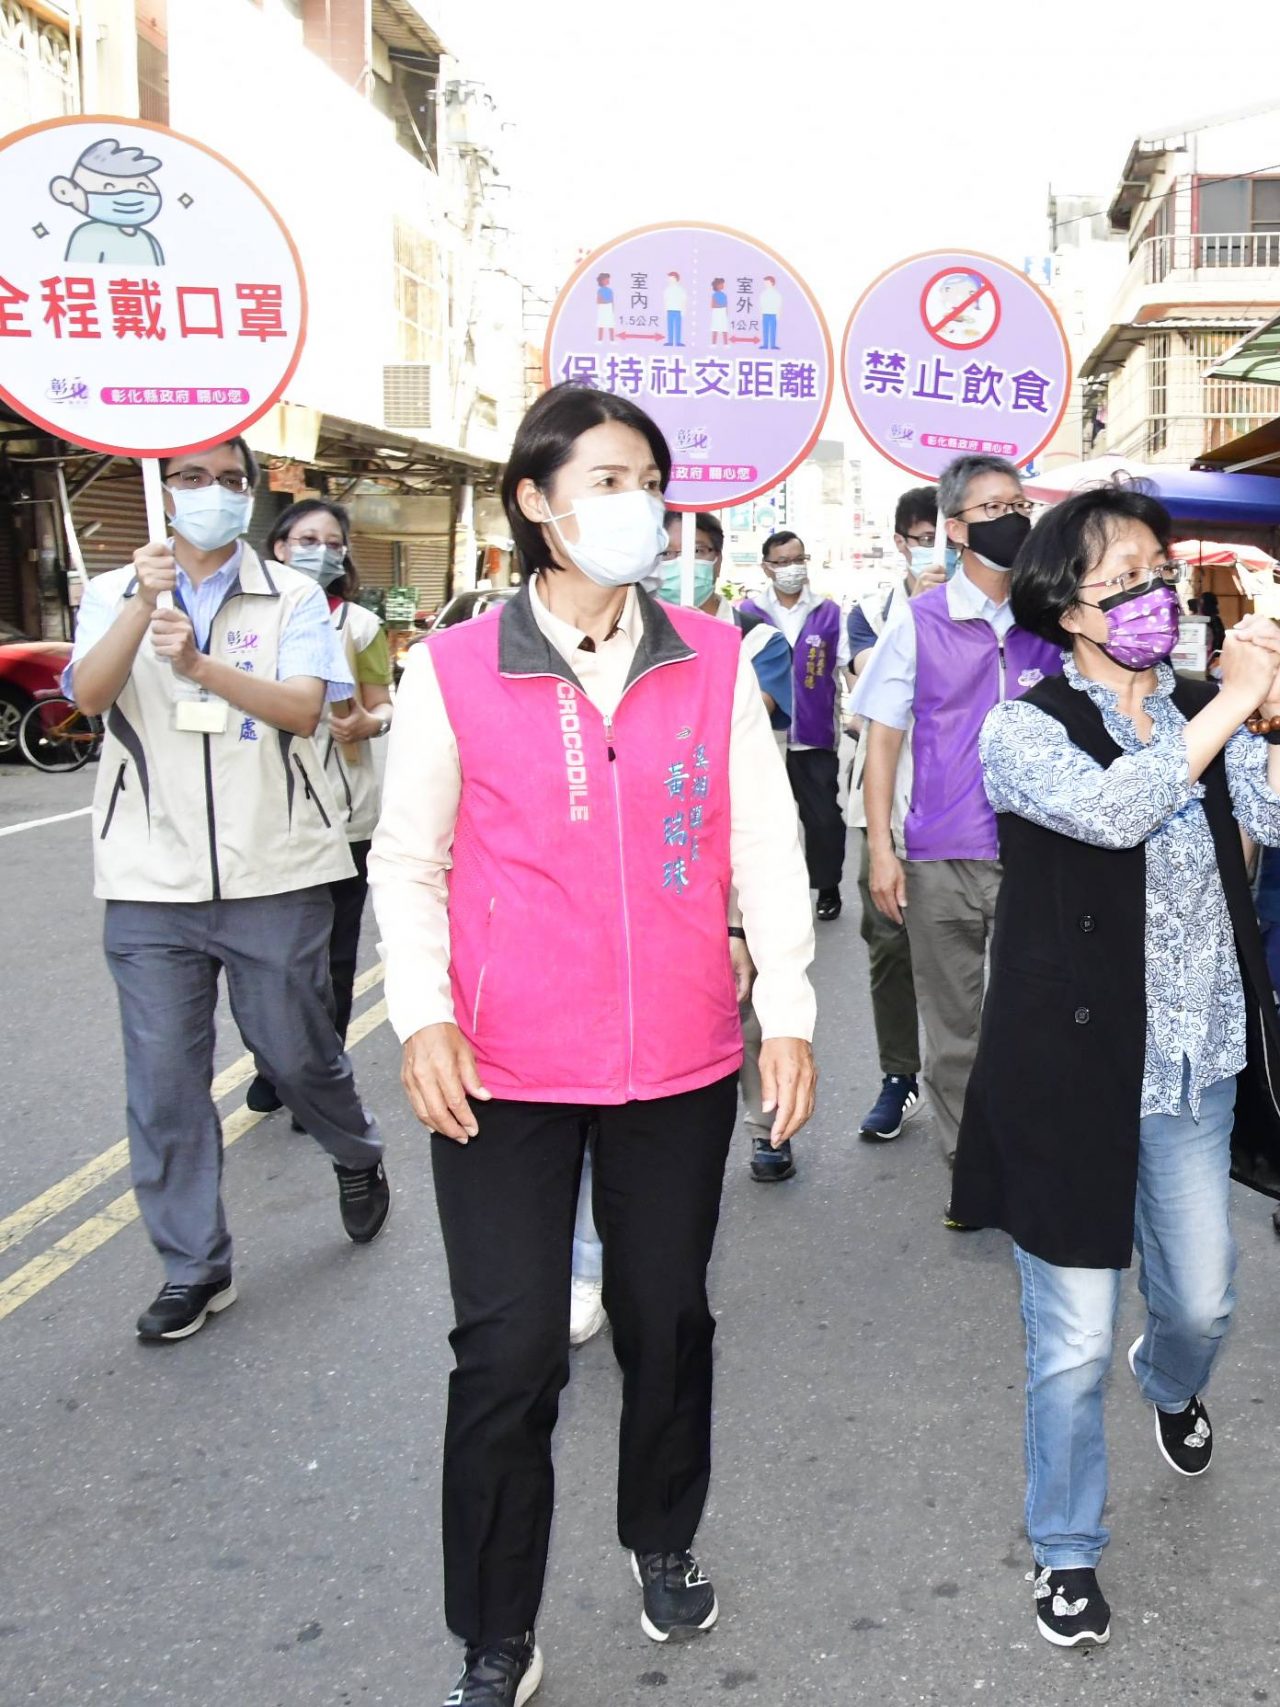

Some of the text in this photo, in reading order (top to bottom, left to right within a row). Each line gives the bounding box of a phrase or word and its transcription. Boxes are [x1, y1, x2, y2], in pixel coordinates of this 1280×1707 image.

[736, 277, 754, 314] 室外
[619, 316, 659, 327] 1.5公尺
[731, 320, 760, 331] 1公尺
[561, 355, 817, 398] 保持社交距離
[864, 350, 1050, 413] 禁止飲食
[111, 389, 242, 404] 彰化縣政府 關心您
[709, 466, 751, 480] 關心您
[556, 682, 589, 822] CROCODILE
